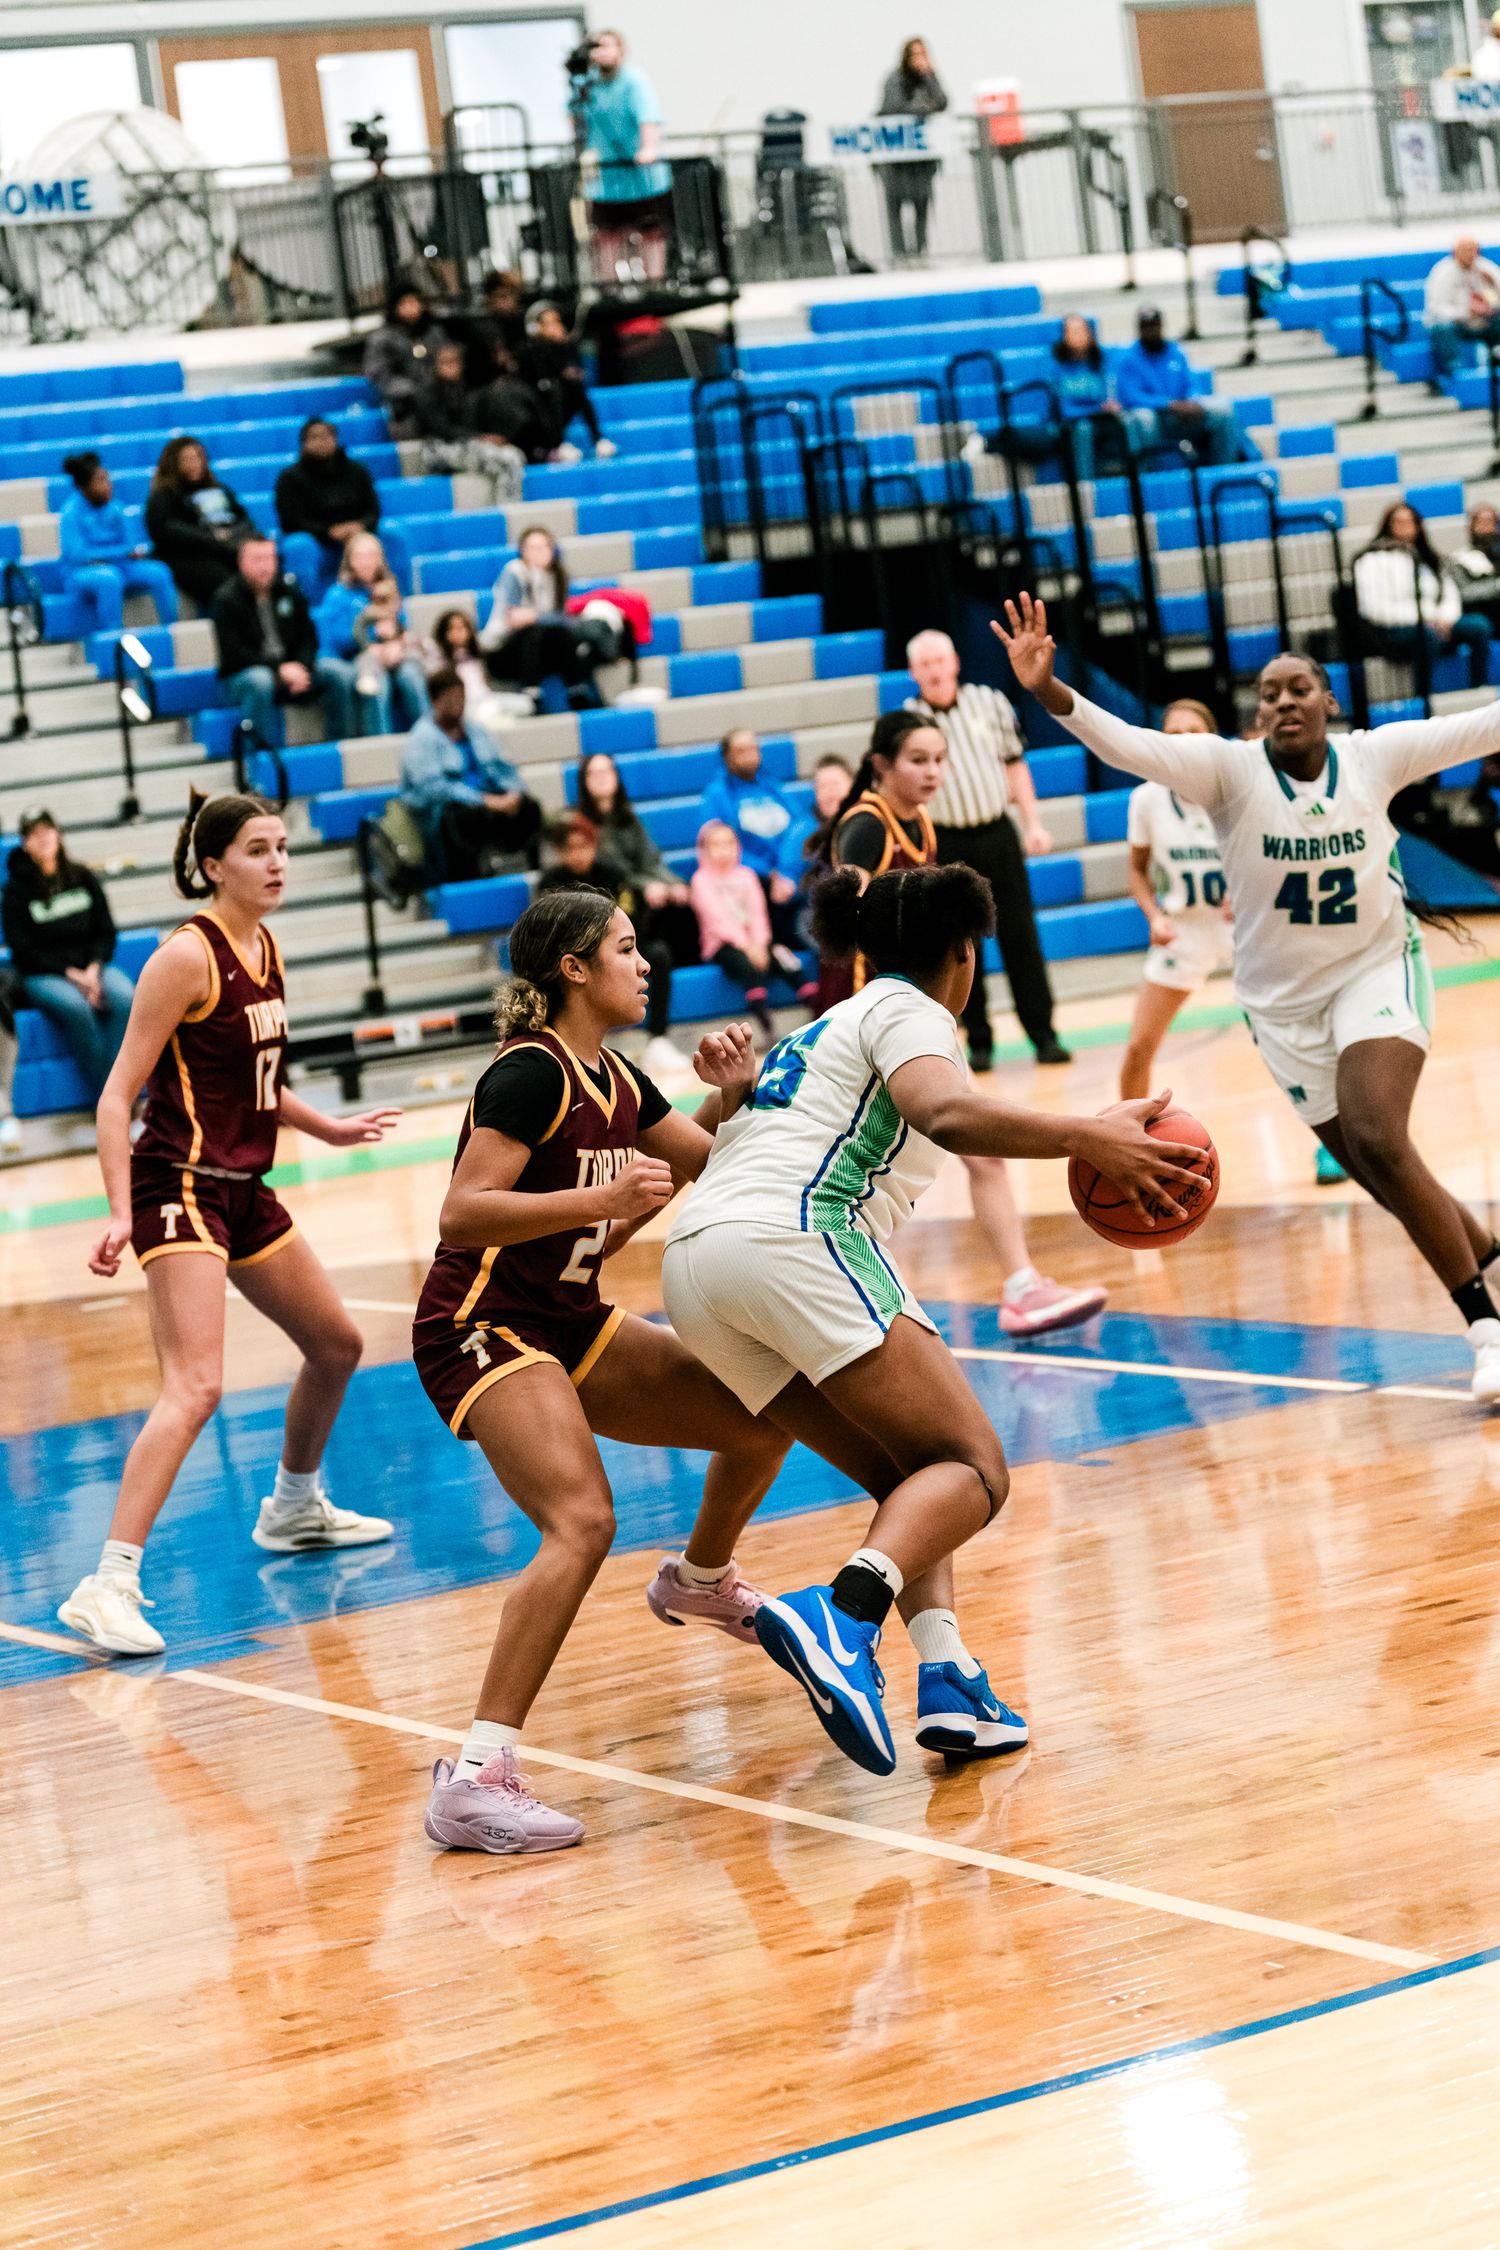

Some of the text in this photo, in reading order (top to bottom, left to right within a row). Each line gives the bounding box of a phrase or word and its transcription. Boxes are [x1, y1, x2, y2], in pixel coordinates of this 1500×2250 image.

[1457, 83, 1500, 109] HO
[831, 120, 927, 153] HOME
[2, 179, 91, 214] OME
[1263, 829, 1366, 861] WARRIORS
[1181, 871, 1226, 907] 10
[1275, 867, 1357, 925] 42
[160, 1203, 183, 1239] T
[460, 1329, 491, 1369] T
